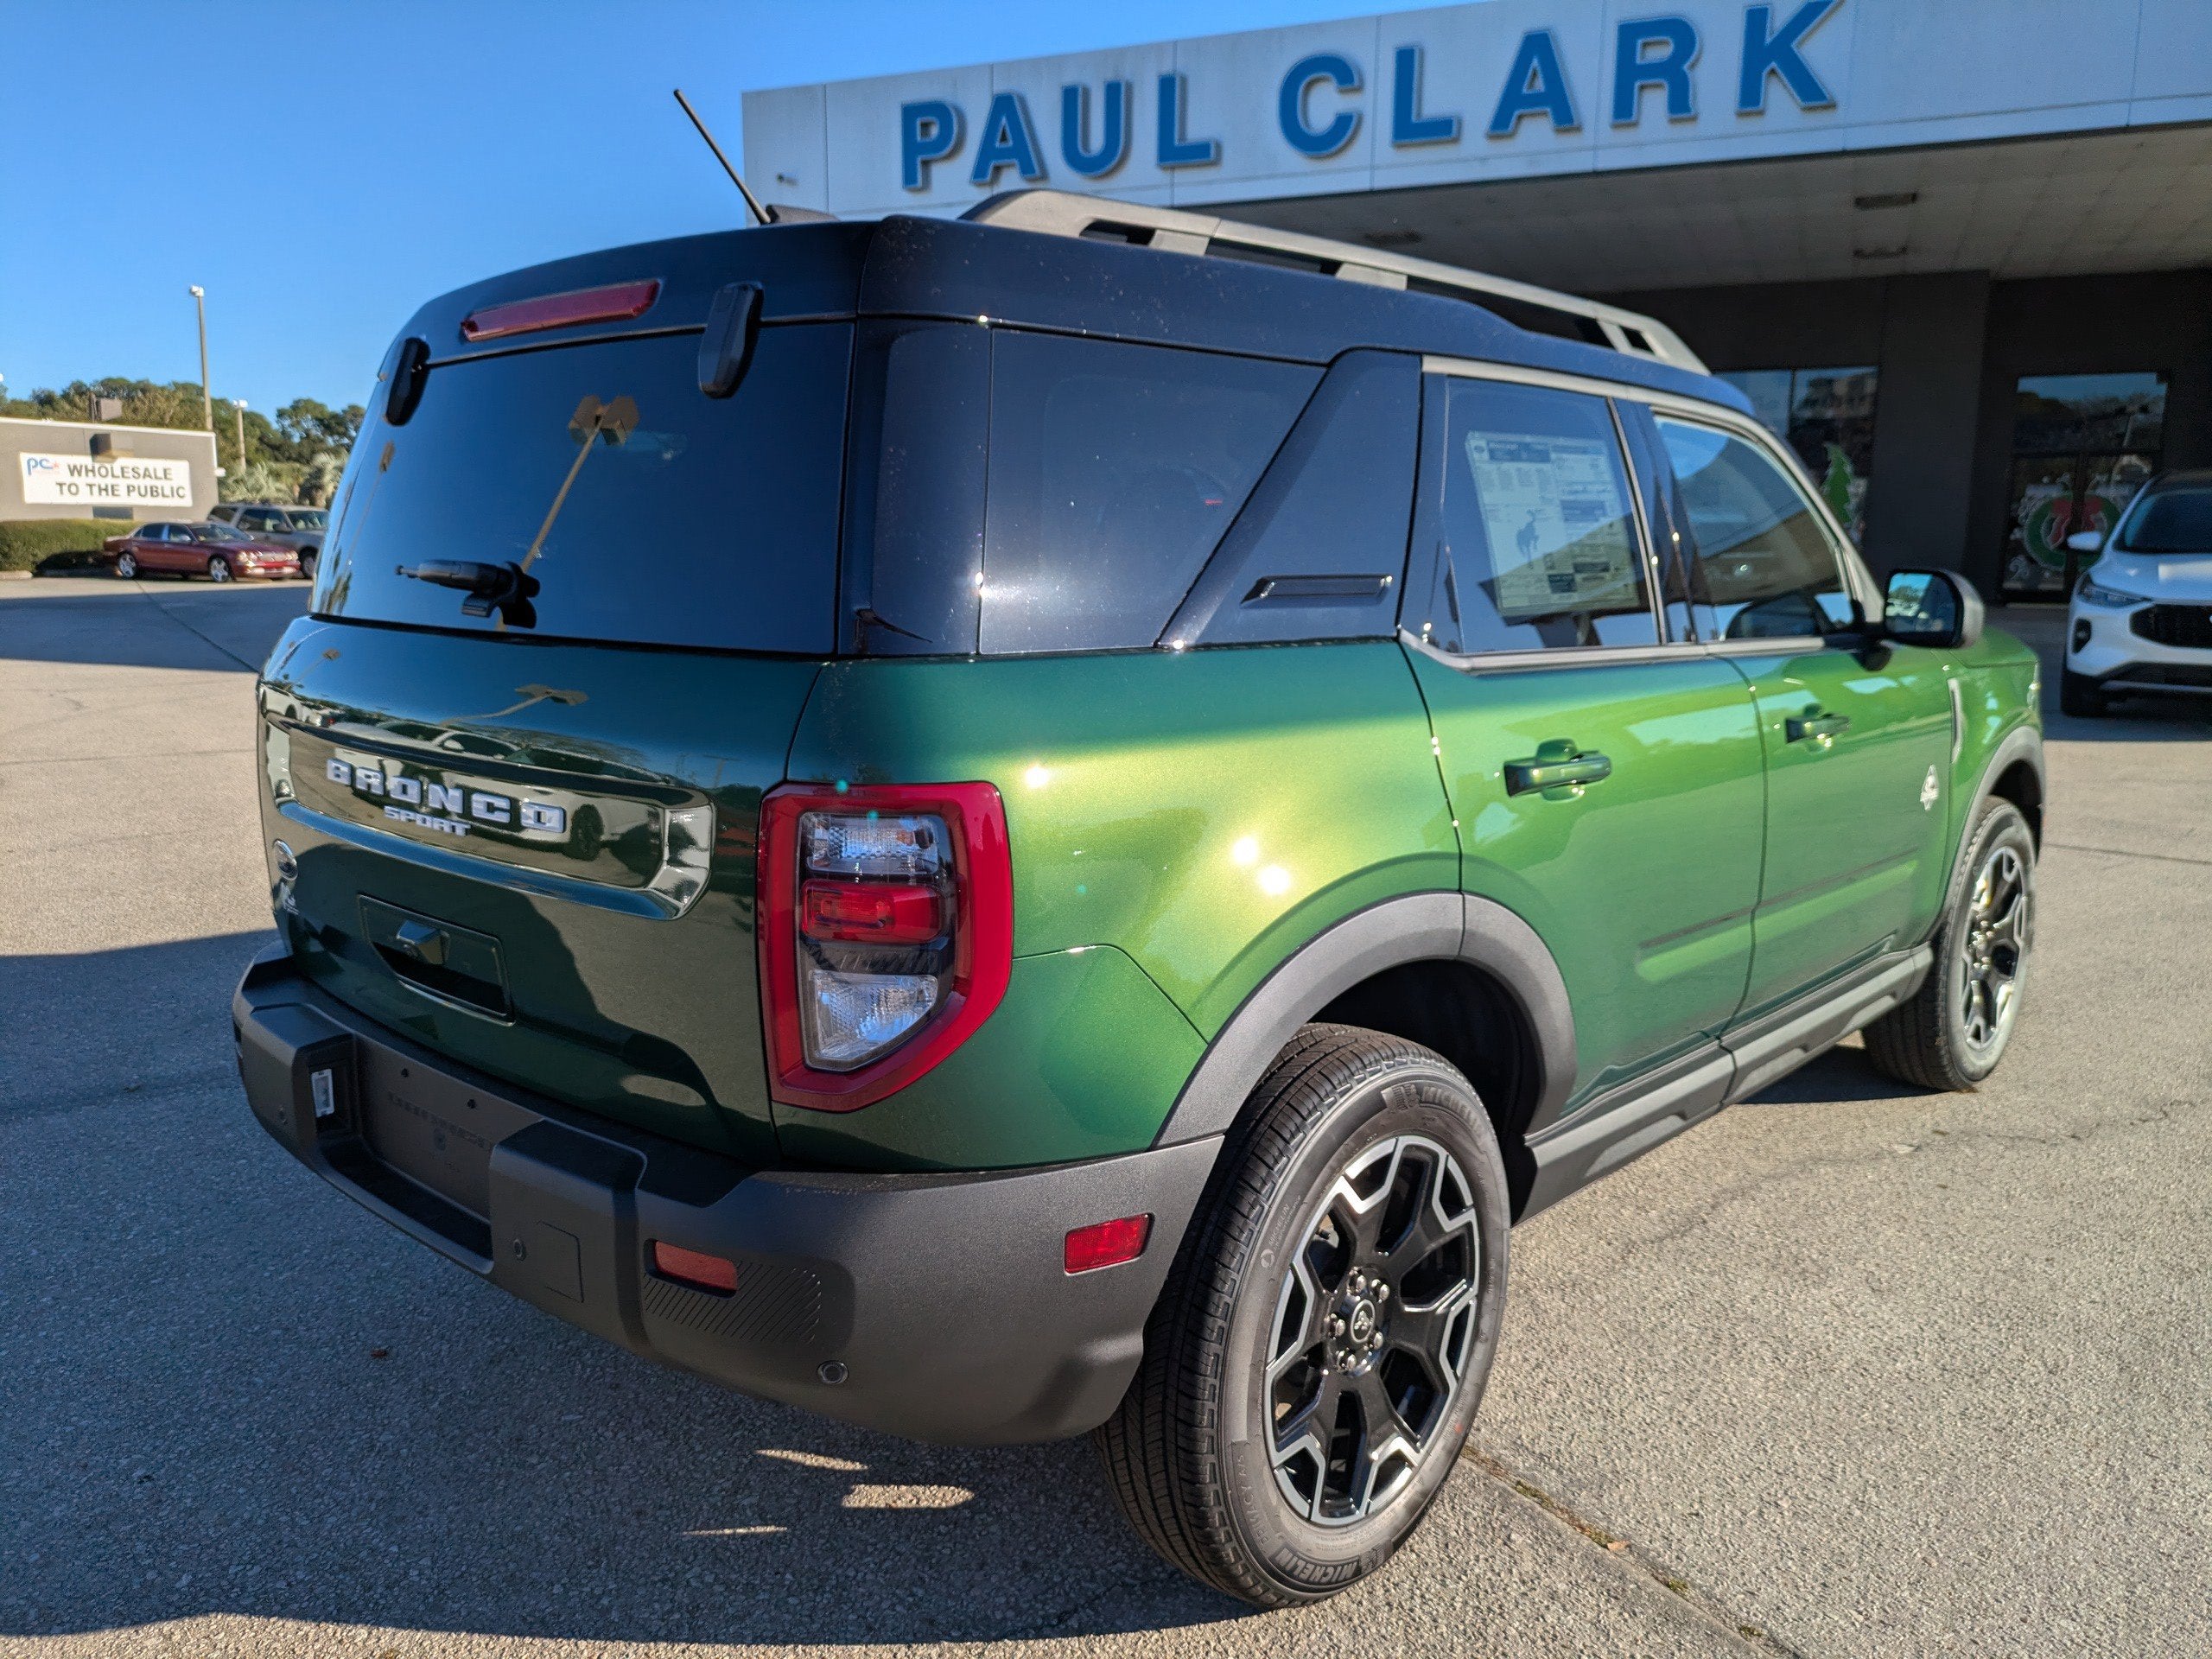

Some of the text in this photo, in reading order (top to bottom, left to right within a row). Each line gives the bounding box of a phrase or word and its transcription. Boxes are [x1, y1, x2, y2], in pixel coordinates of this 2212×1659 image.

[902, 0, 1842, 188] PAUL CLARK
[67, 463, 173, 480] WHOLESALE
[55, 482, 187, 499] TO THE PUBLIC
[327, 758, 565, 833] BRONCO
[384, 805, 472, 836] SPORT
[1274, 1548, 1357, 1585] MICHELIN
